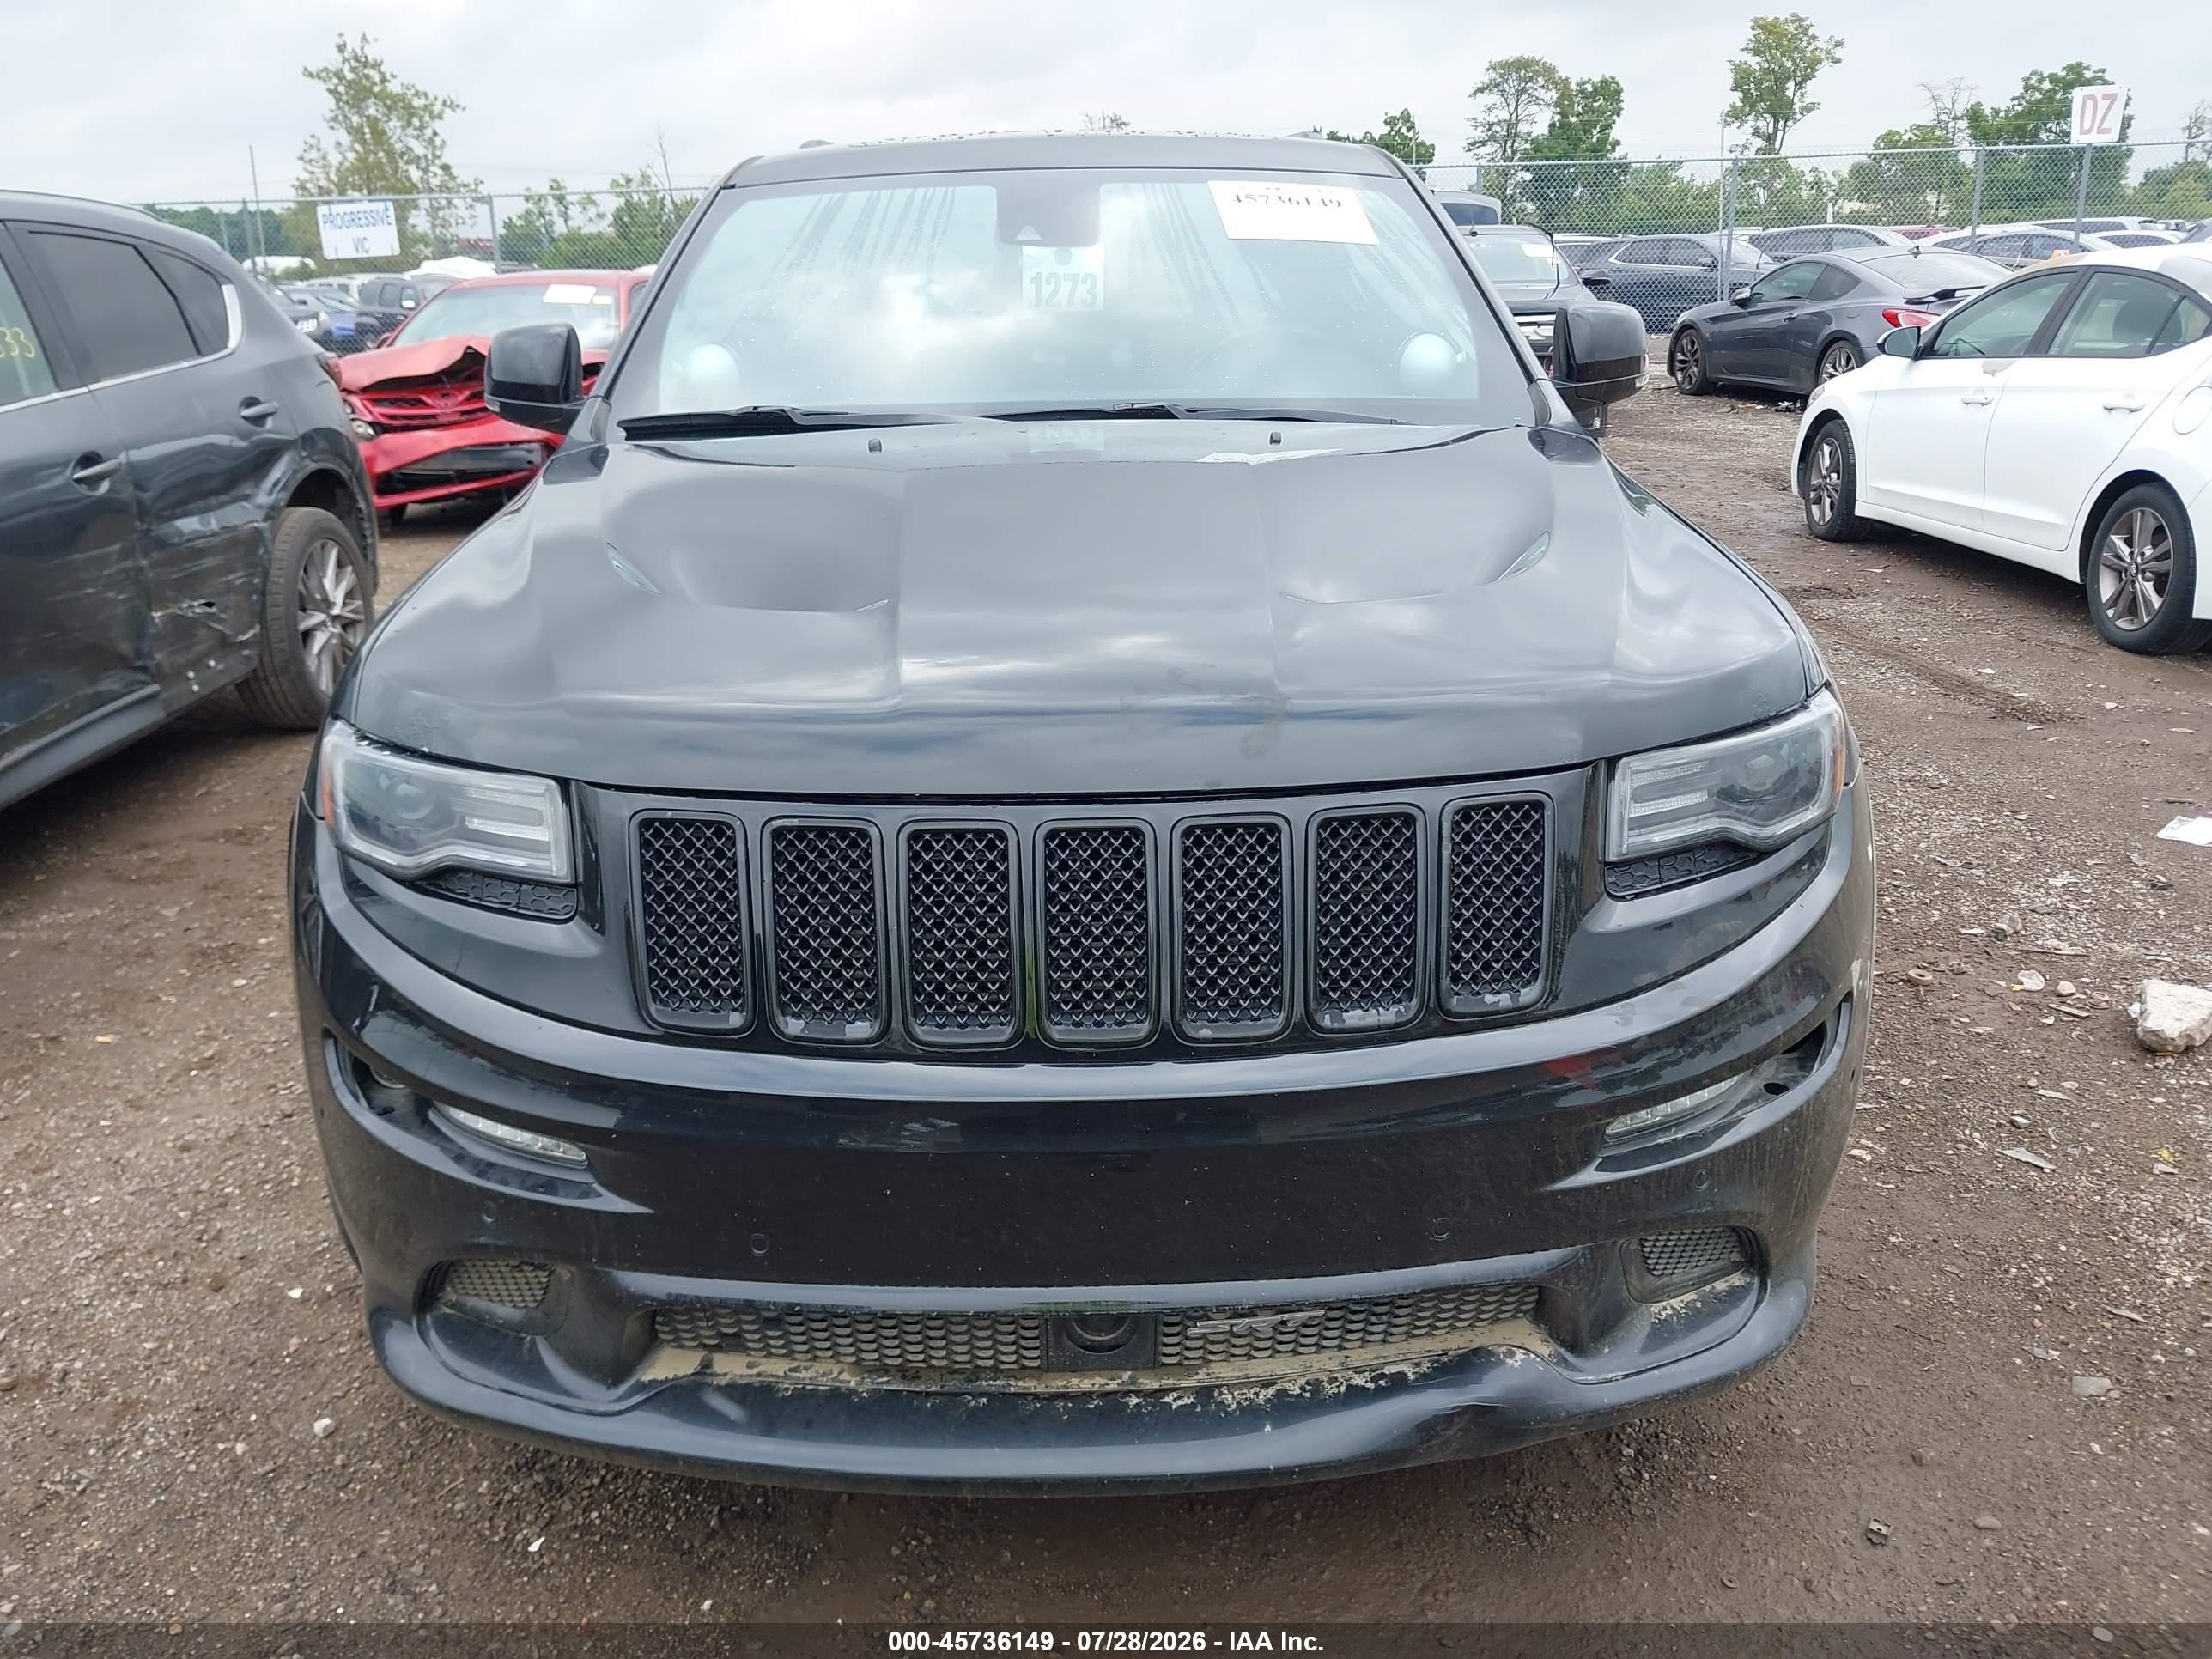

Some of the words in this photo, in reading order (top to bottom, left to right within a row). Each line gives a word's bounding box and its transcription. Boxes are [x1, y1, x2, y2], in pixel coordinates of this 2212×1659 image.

[2079, 93, 2118, 135] DZ
[322, 208, 392, 230] PROGRESSIVE
[1030, 271, 1098, 310] 1273
[0, 326, 35, 358] 33
